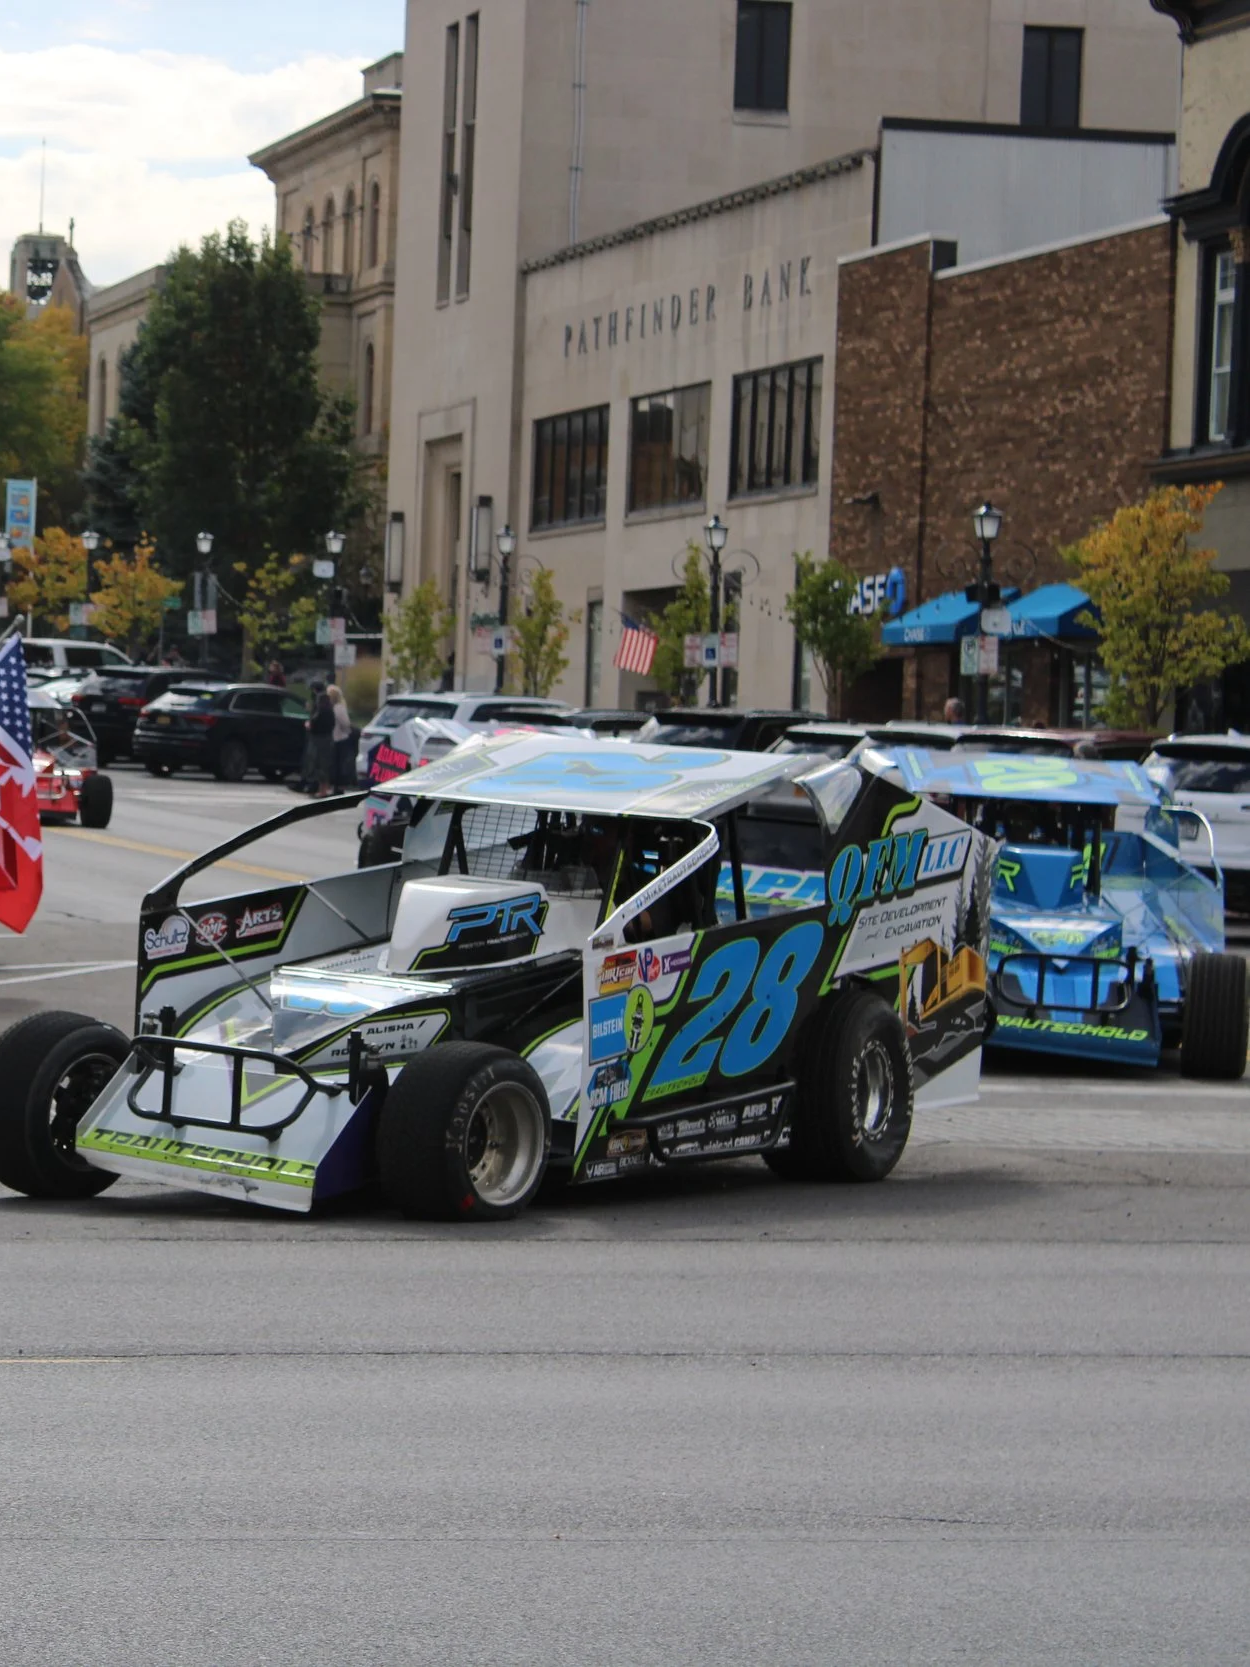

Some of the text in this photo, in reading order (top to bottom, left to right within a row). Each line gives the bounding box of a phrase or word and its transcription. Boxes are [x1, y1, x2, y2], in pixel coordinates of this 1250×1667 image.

[564, 256, 812, 358] PATHFINDER BANK
[828, 828, 965, 926] QFM LLC
[446, 894, 542, 943] PTR
[146, 926, 187, 950] Schultz
[648, 920, 824, 1089] 28
[366, 1022, 414, 1035] ALISHA
[592, 1017, 624, 1039] BILSTEIN
[996, 1014, 1149, 1041] RAUTSCHOLD
